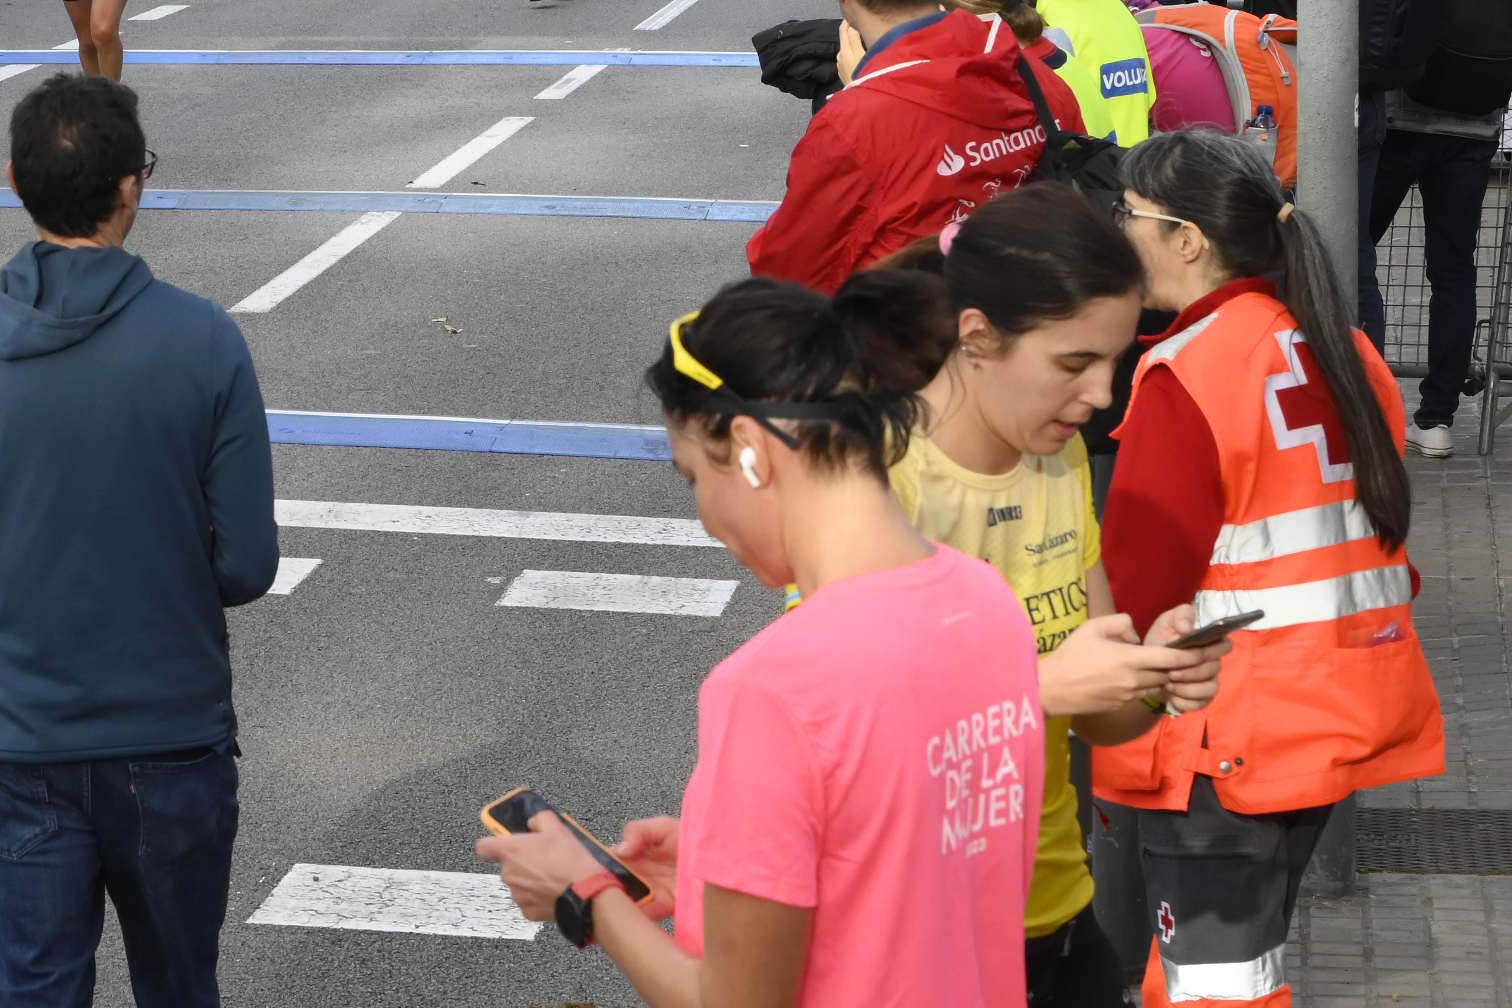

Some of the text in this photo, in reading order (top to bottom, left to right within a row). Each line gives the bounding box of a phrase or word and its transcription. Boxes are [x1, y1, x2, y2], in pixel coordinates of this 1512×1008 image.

[964, 118, 1062, 167] Santanr
[926, 694, 1038, 777] CARRERA
[945, 744, 1021, 810] DE LA
[941, 784, 1025, 855] MUJER
